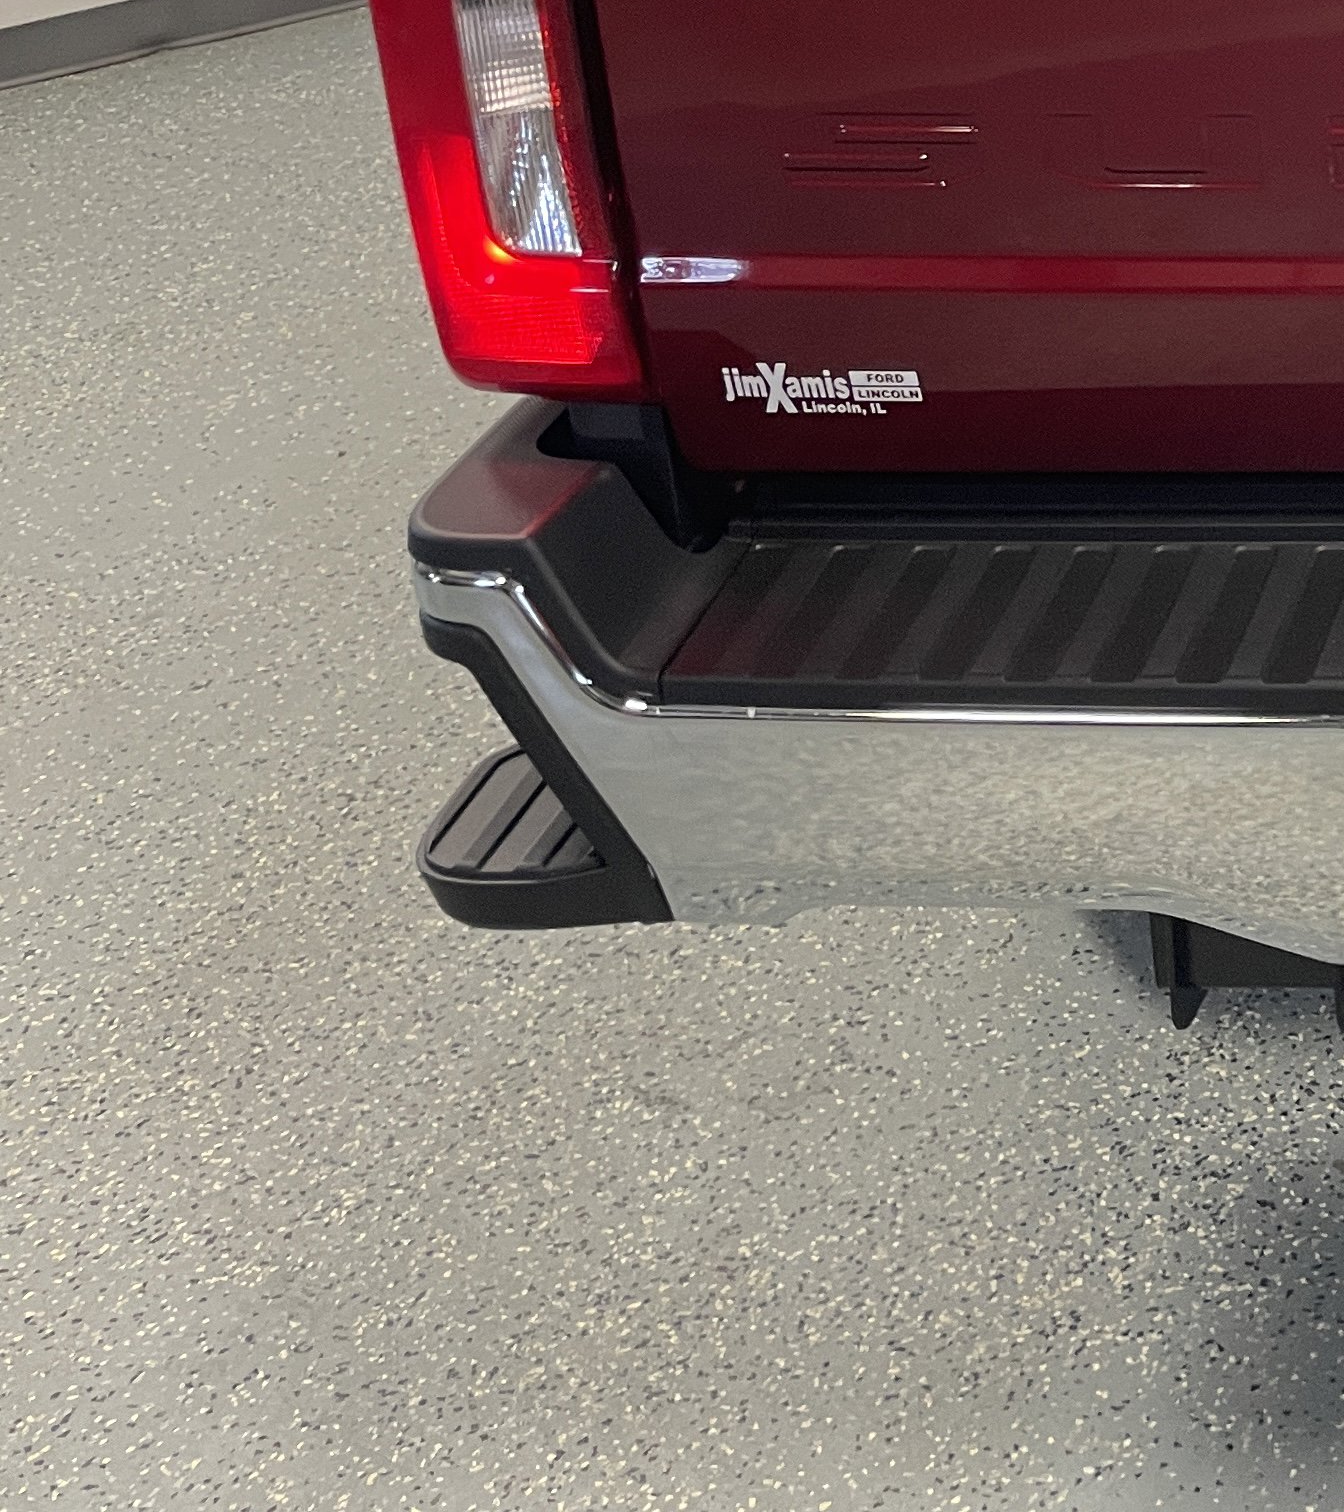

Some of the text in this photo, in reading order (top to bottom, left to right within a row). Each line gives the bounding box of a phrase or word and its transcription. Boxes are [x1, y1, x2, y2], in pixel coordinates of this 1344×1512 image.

[866, 373, 905, 384] FORD
[857, 389, 919, 400] LINCOLN
[801, 401, 887, 416] Lincoln, IL
